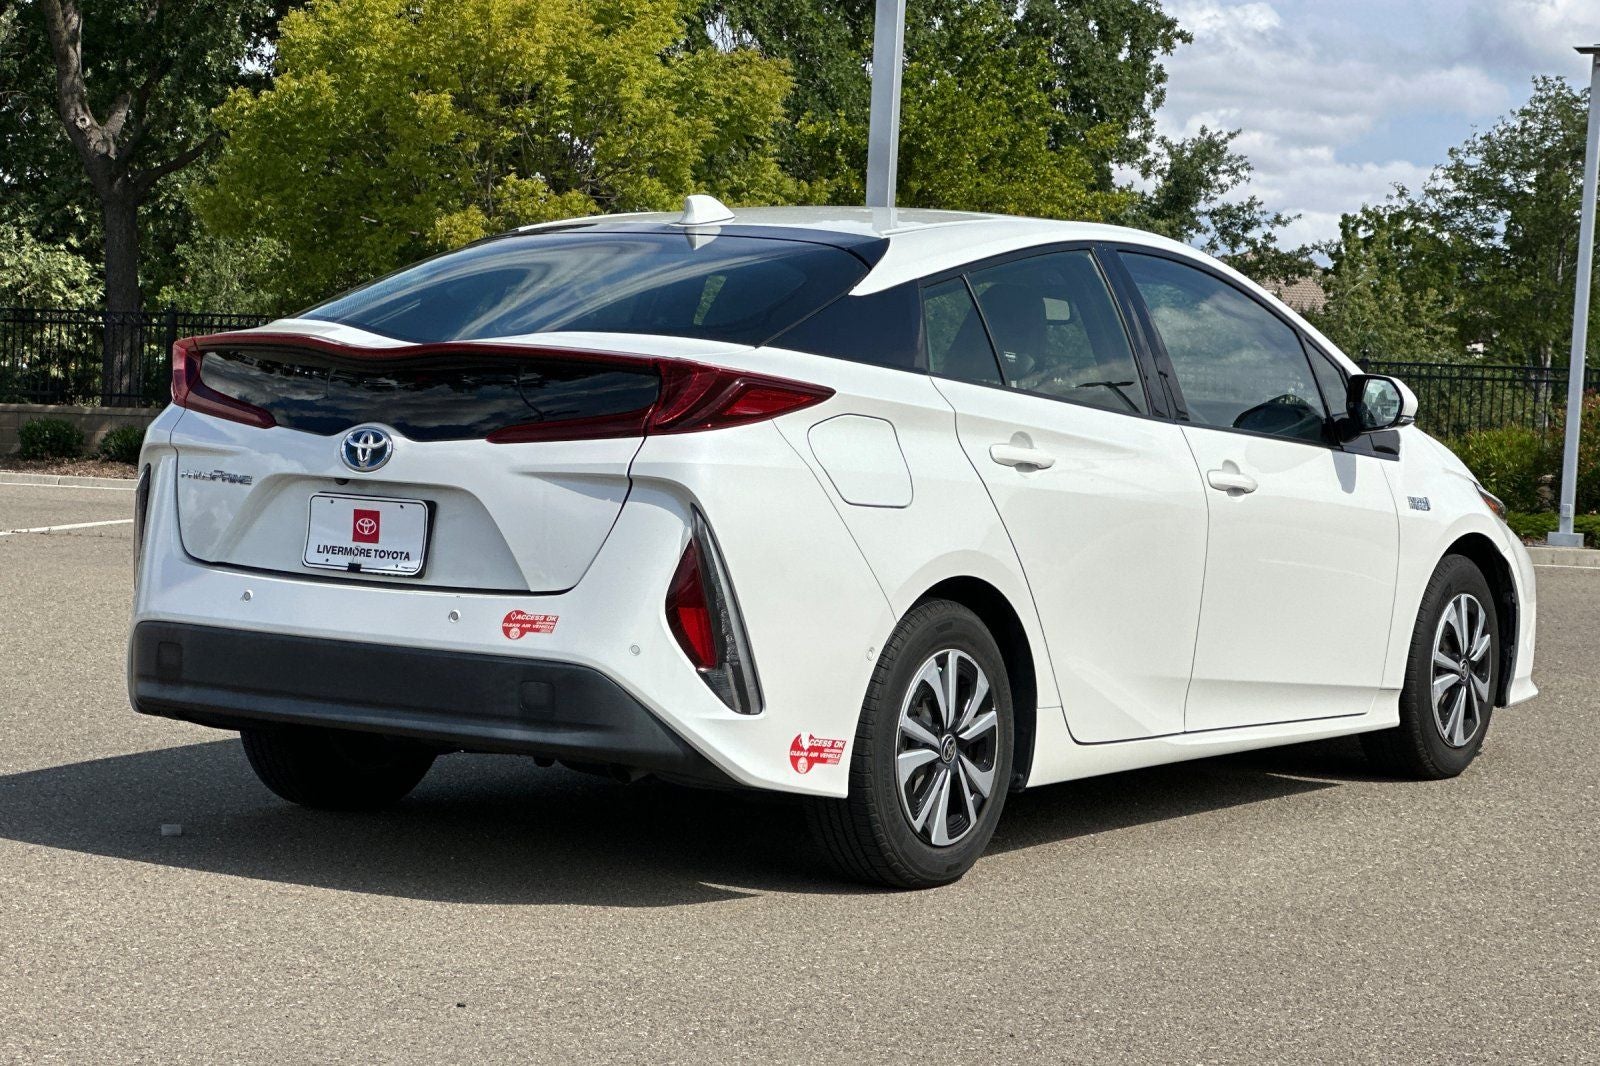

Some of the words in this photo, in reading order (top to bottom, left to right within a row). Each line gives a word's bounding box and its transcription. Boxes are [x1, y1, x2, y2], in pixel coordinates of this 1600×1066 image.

[317, 544, 372, 558] LIVERMORE
[374, 548, 411, 562] TOYOTA
[809, 739, 832, 748] CCESS
